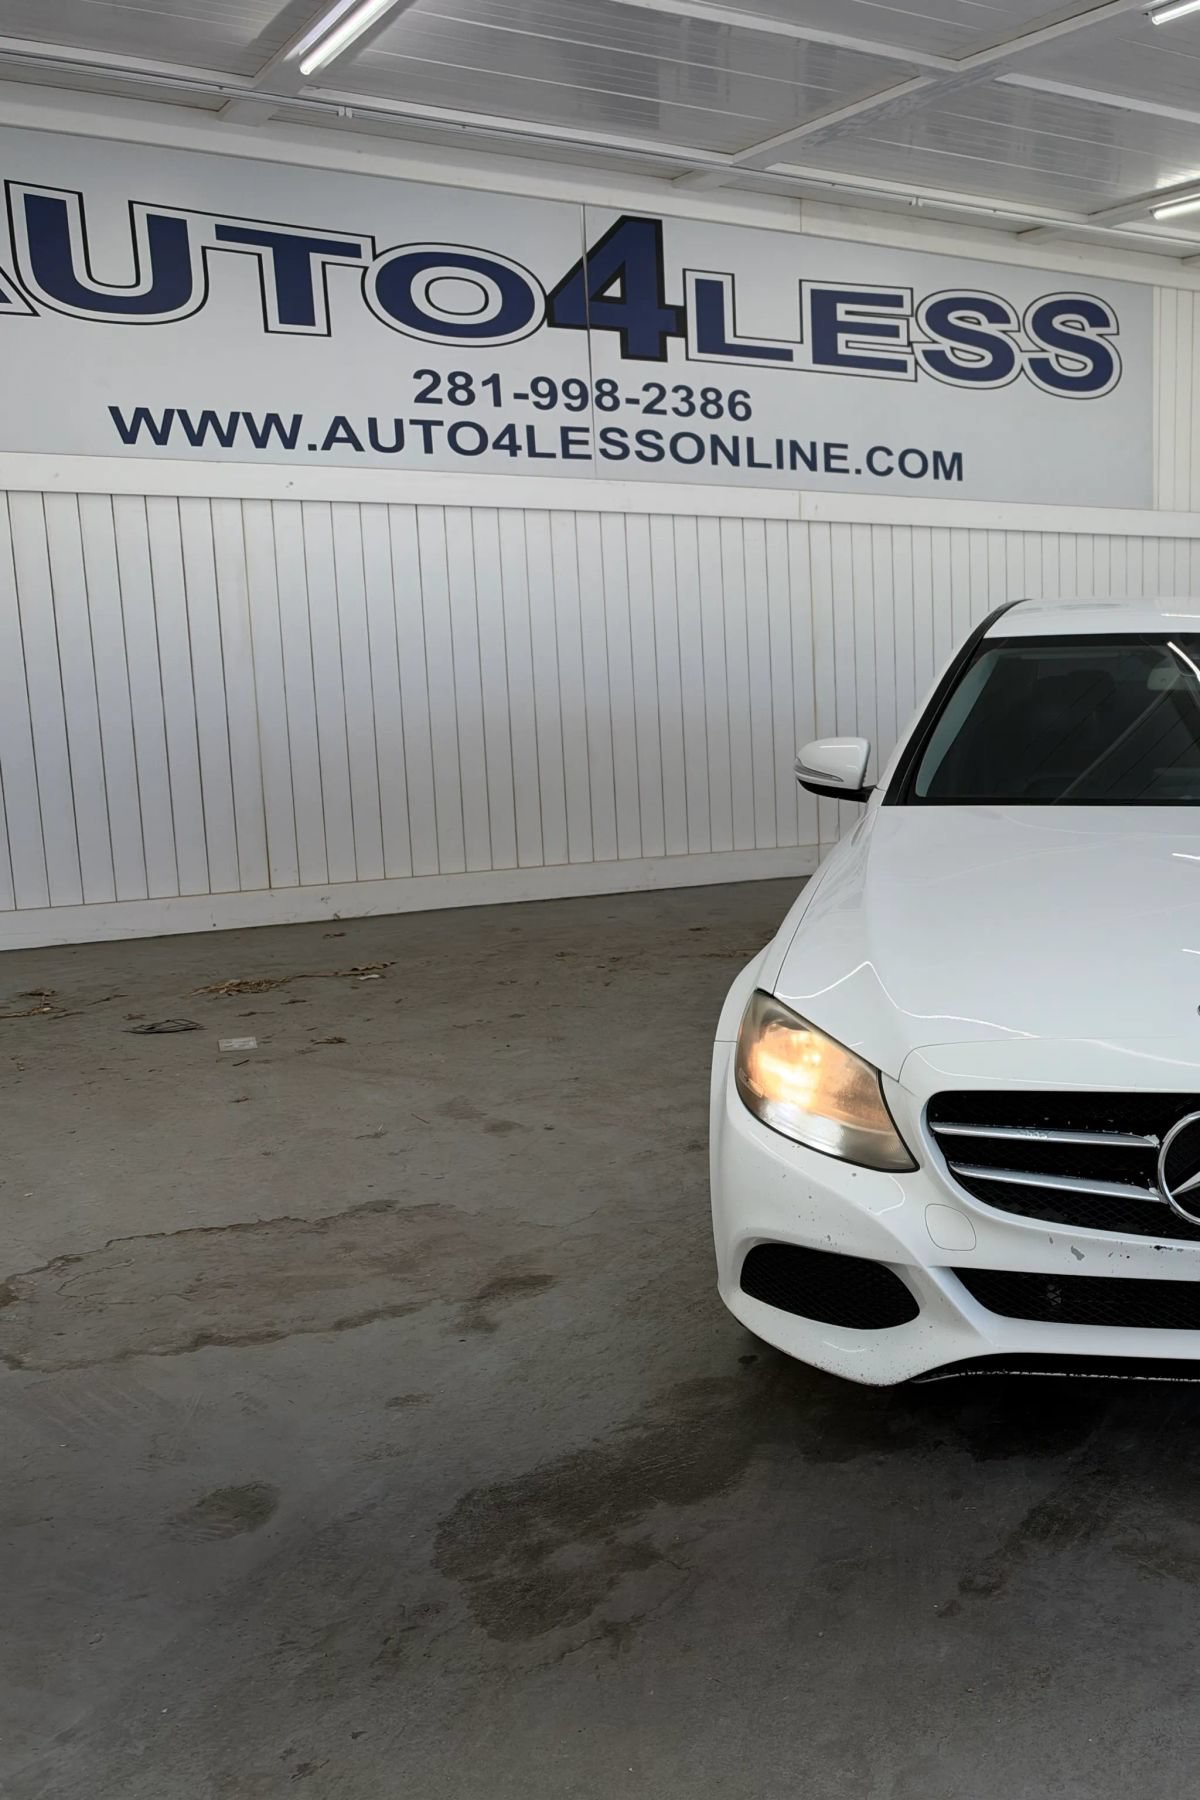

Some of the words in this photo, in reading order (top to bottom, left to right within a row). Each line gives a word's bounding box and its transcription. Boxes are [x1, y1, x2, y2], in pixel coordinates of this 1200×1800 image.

[0, 179, 1123, 400] UTO4LESS
[412, 368, 753, 422] 281-998-2386
[108, 404, 964, 482] WWW.AUTO4LESSONLINE.COM
